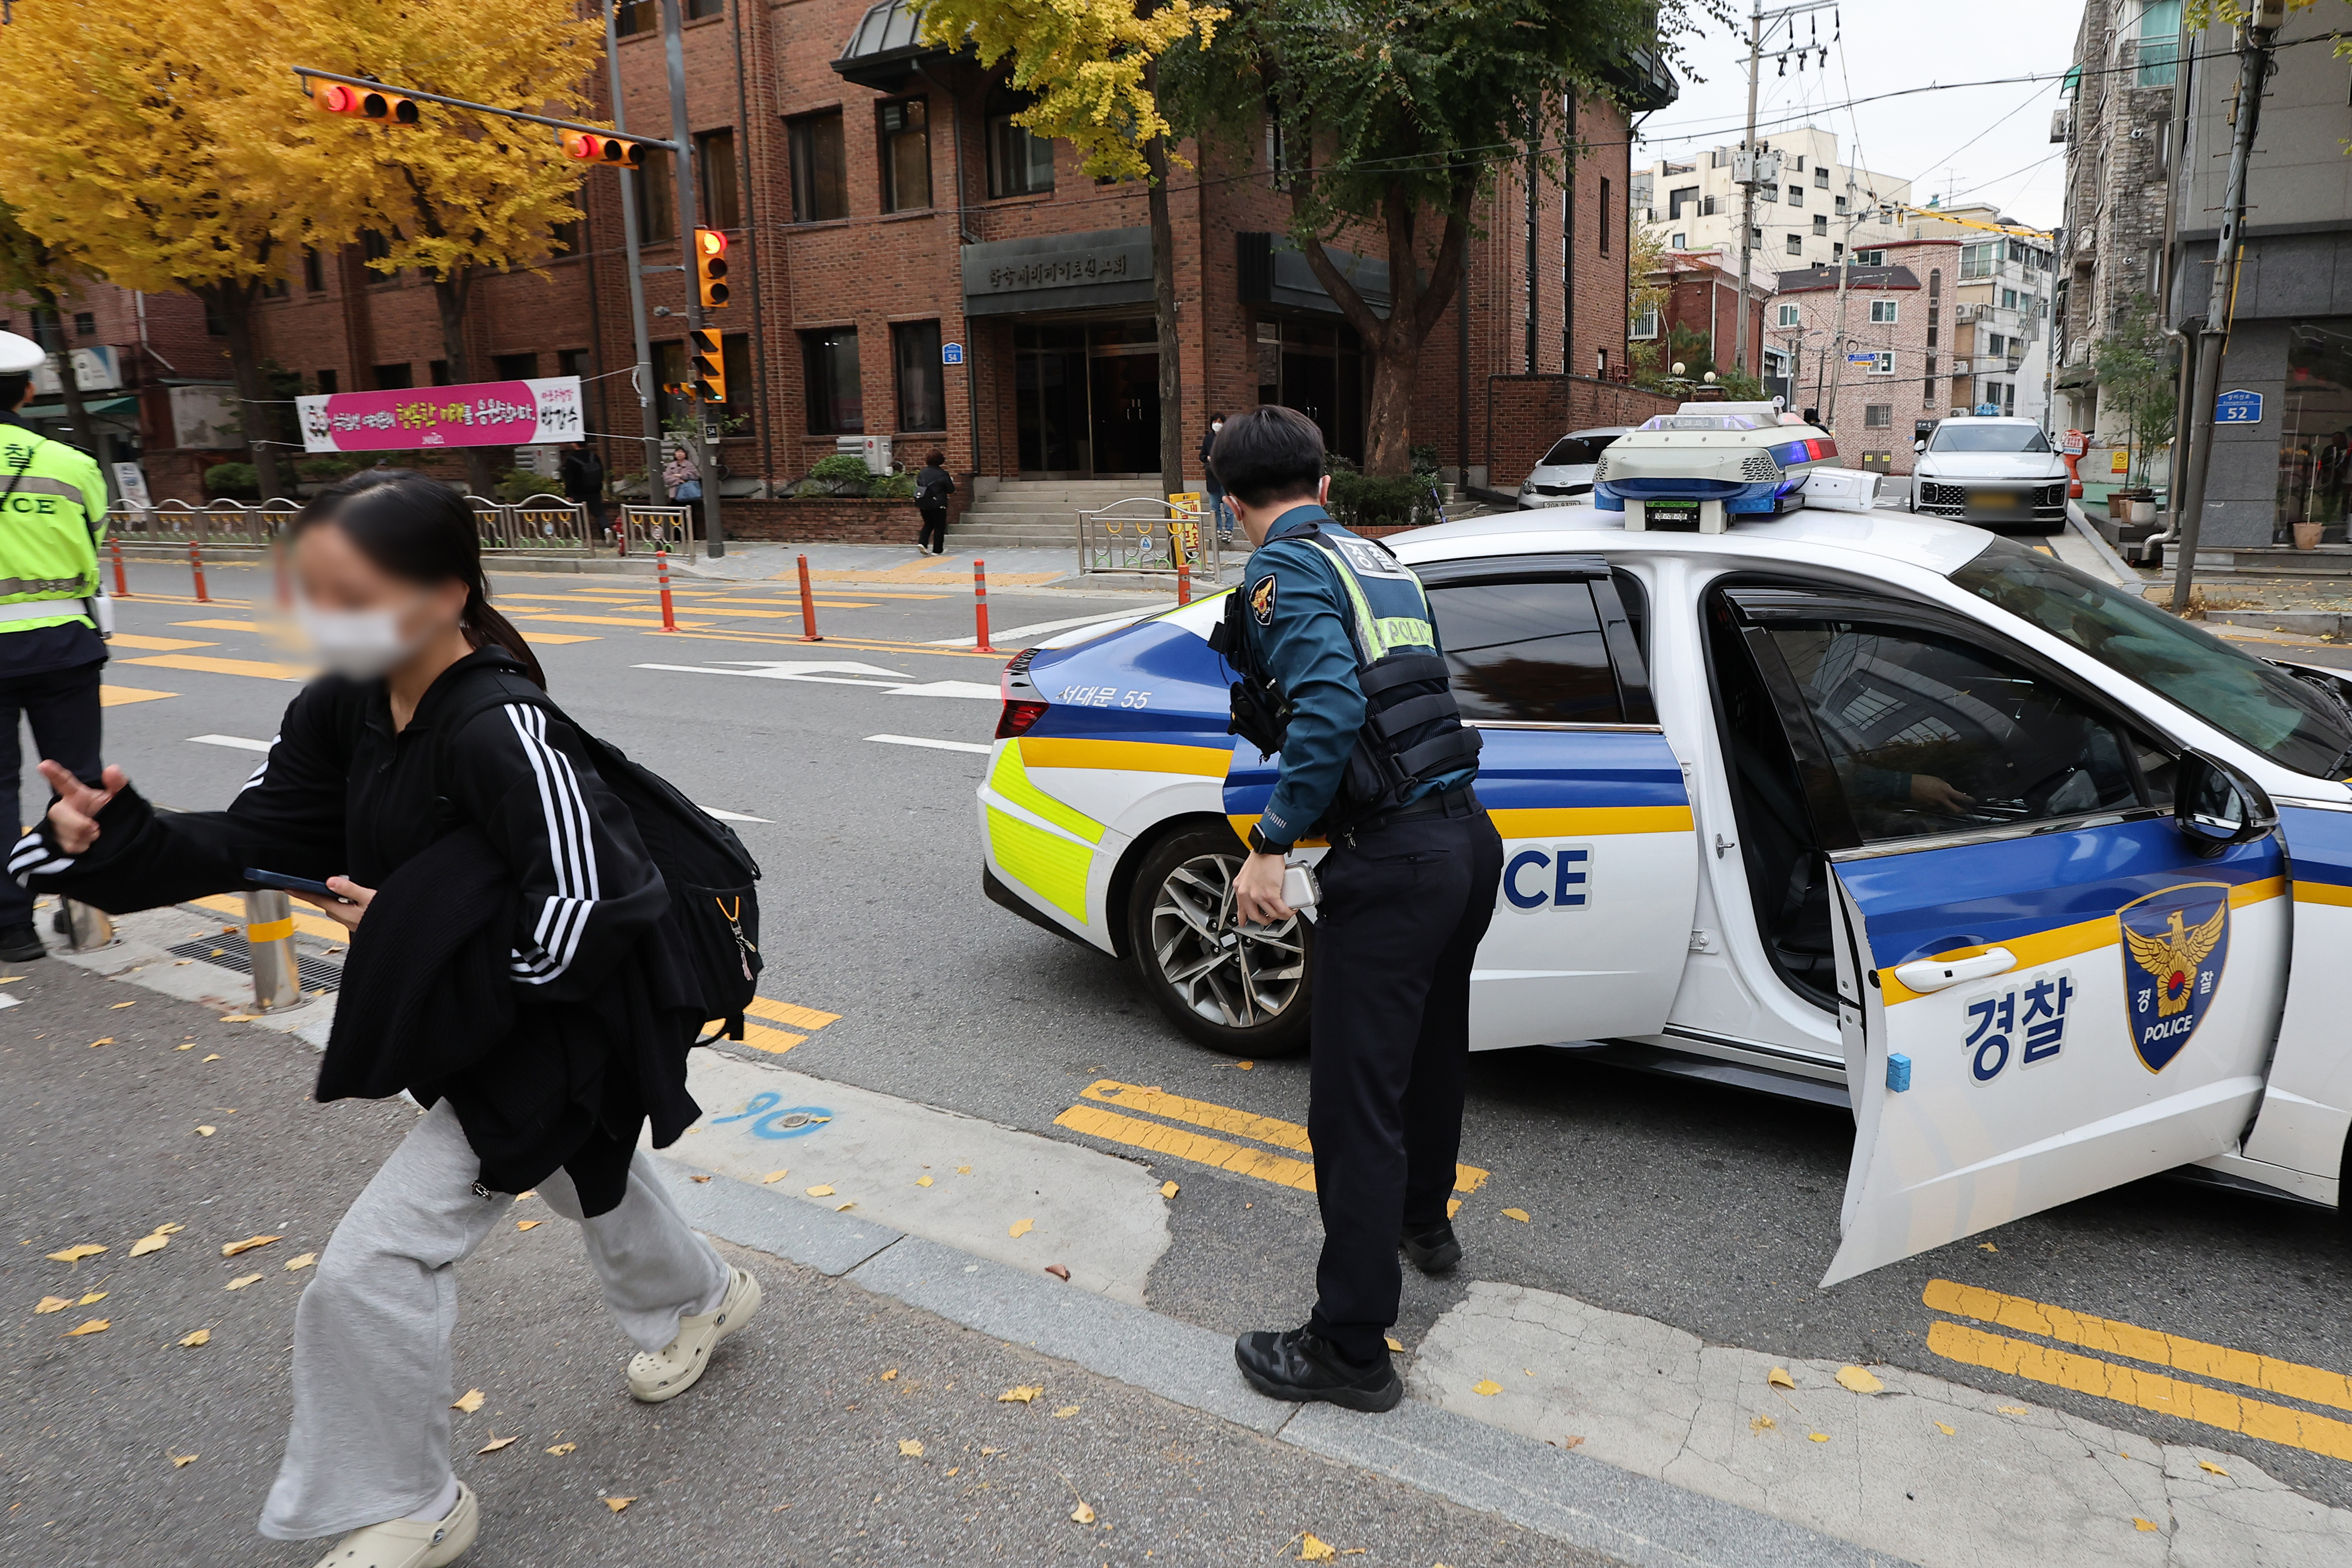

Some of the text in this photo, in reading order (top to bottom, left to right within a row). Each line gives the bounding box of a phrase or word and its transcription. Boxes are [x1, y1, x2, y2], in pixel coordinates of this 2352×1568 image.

[395, 402, 437, 430] 행복한
[540, 406, 578, 433] 박강수
[2227, 406, 2248, 419] 52
[1344, 543, 1398, 571] 경찰
[1055, 686, 1152, 709] 서대문 55
[2137, 971, 2214, 1013] 경 찰
[1966, 977, 2073, 1081] 경찰
[2143, 1015, 2193, 1044] POLICE
